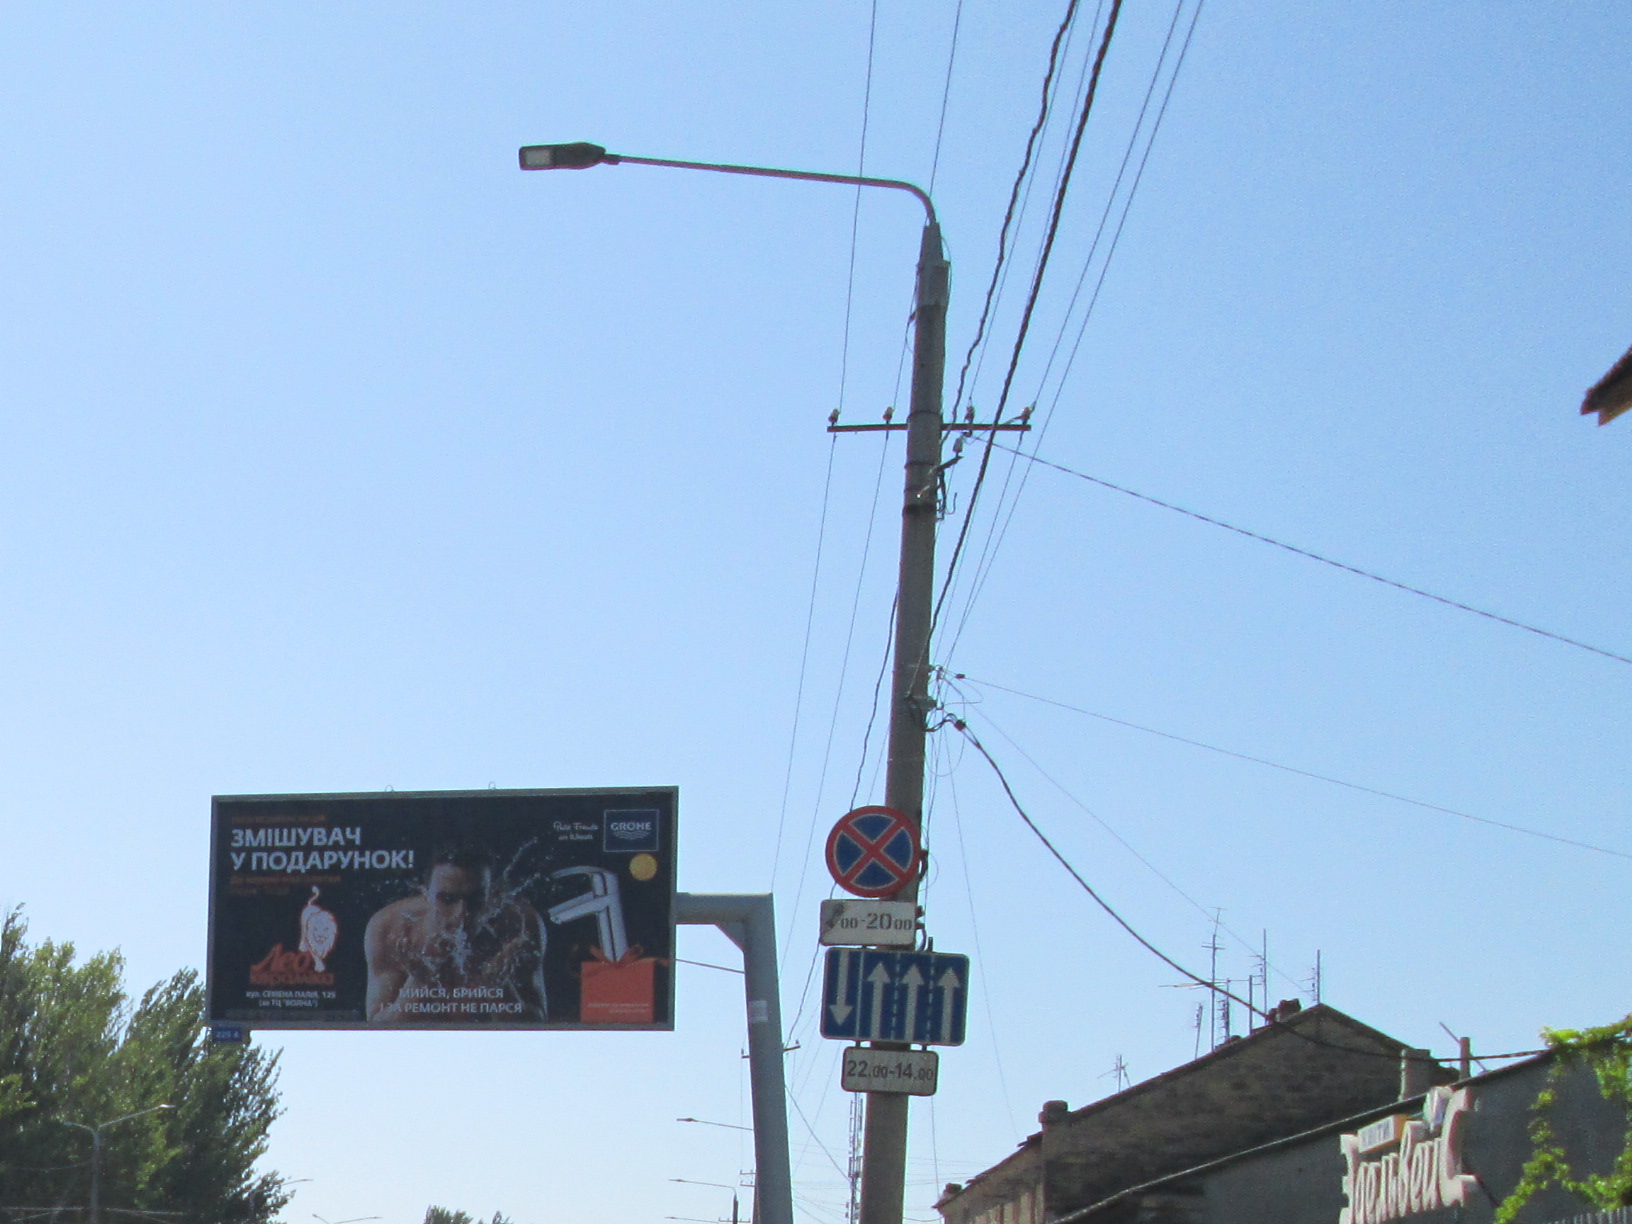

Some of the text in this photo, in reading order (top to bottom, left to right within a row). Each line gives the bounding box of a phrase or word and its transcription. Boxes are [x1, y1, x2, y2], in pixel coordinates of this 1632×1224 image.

[609, 821, 652, 831] GROHE
[230, 826, 362, 848] ЗМІШУВАЧ
[230, 849, 415, 873] У ПОДАРУНОК!
[452, 986, 504, 999] БРИЙСЯ
[405, 1002, 460, 1014] РЕМОНТ
[461, 1002, 478, 1013] НЕ
[480, 1001, 523, 1014] ПАРСЯ
